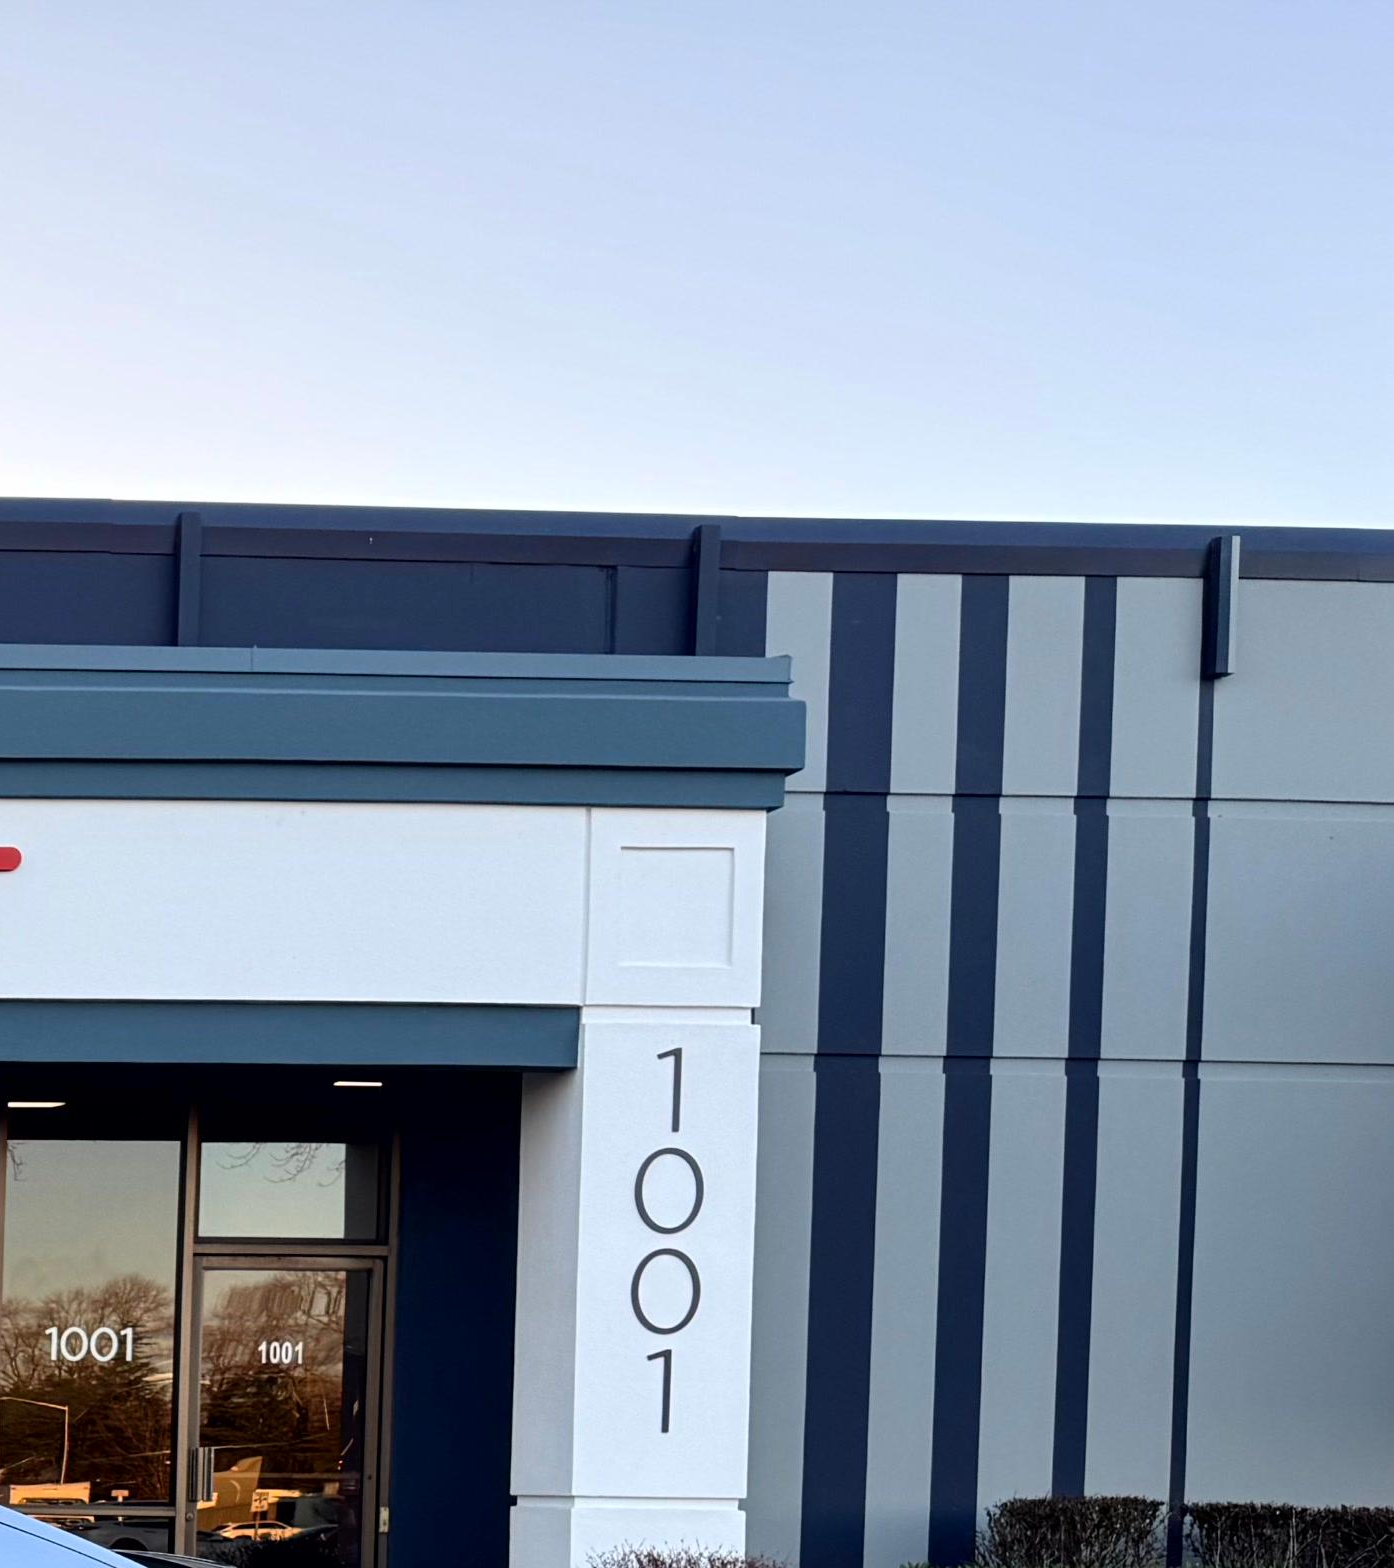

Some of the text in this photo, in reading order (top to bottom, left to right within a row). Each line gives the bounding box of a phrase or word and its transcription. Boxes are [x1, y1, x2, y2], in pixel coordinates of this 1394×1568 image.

[630, 1047, 704, 1434] 1001
[44, 1326, 133, 1362] 1001
[258, 1341, 304, 1365] 1001
